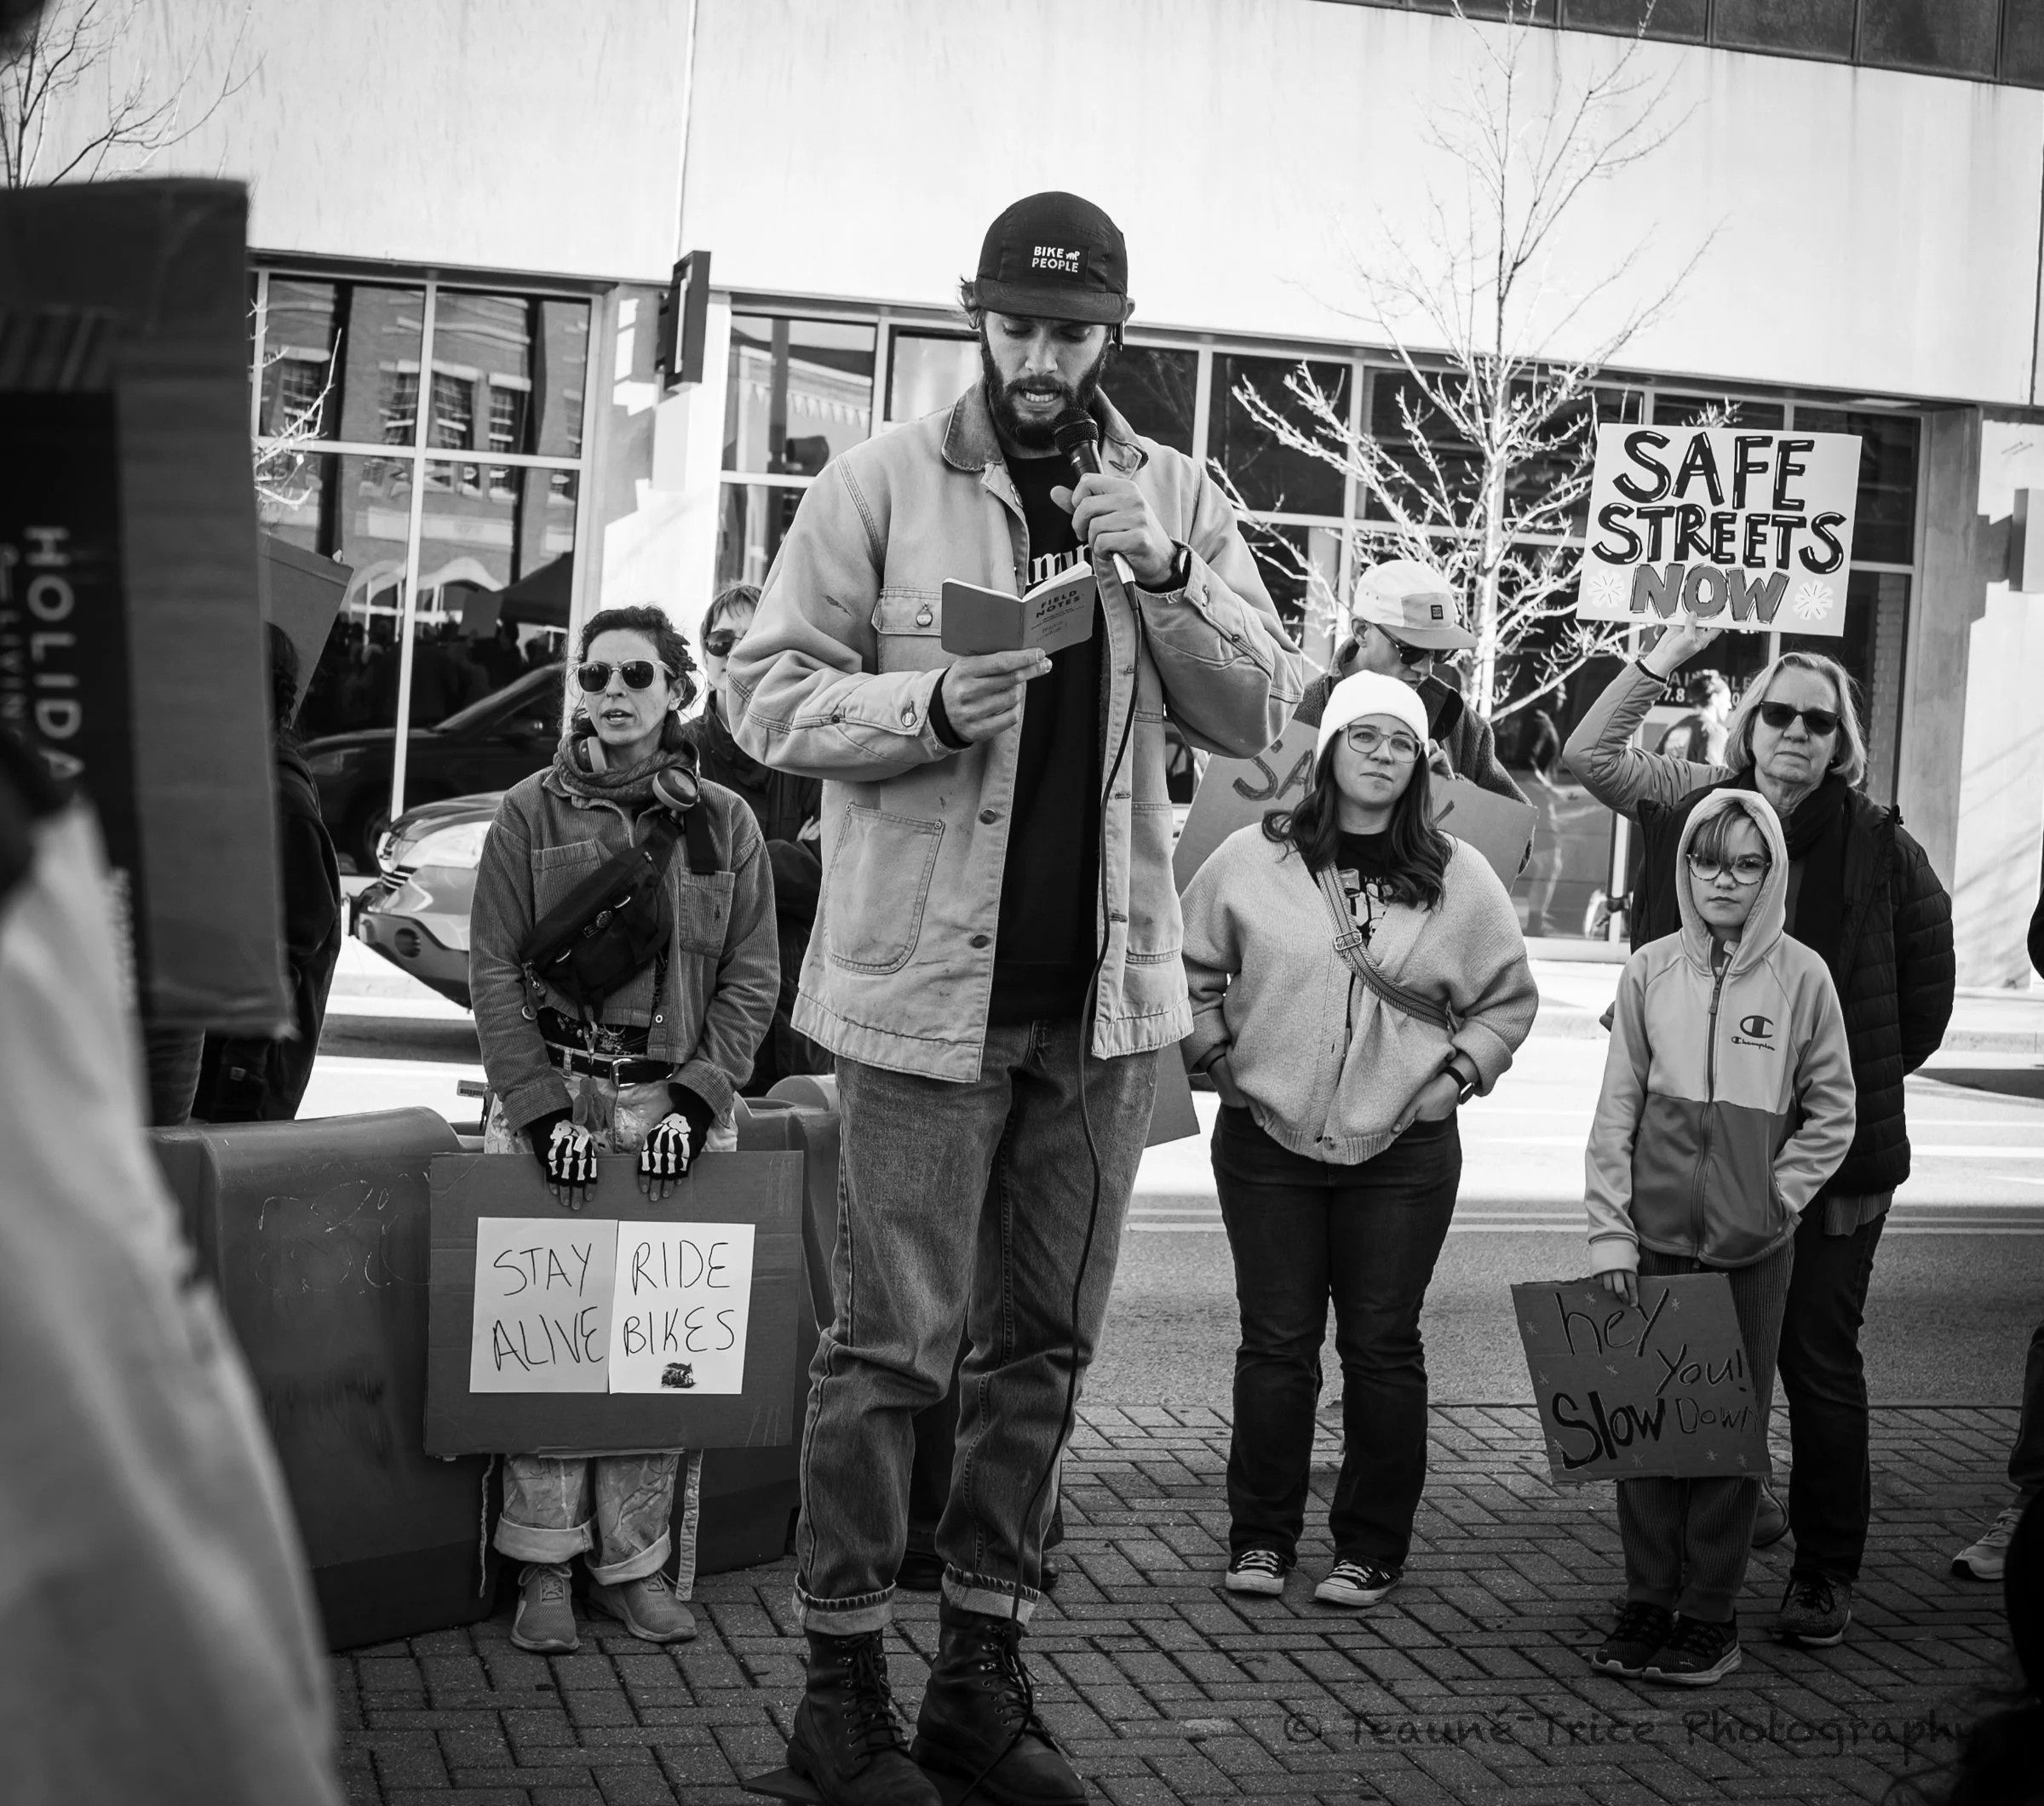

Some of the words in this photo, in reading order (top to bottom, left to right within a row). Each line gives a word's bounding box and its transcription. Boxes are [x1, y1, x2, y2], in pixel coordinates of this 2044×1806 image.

[1031, 257, 1079, 272] PEOPLE
[1034, 246, 1065, 258] BIKE
[1612, 430, 1815, 512] SAFE
[1591, 502, 1847, 575] STREETS
[1036, 595, 1081, 619] NOTES
[1041, 590, 1077, 610] FIELD
[1629, 563, 1790, 625] NOW
[24, 525, 85, 780] HOLIDA
[493, 1243, 593, 1297] STAY
[632, 1240, 731, 1296] RIDE
[492, 1306, 605, 1372] ALIVE
[623, 1306, 735, 1357] BIKES
